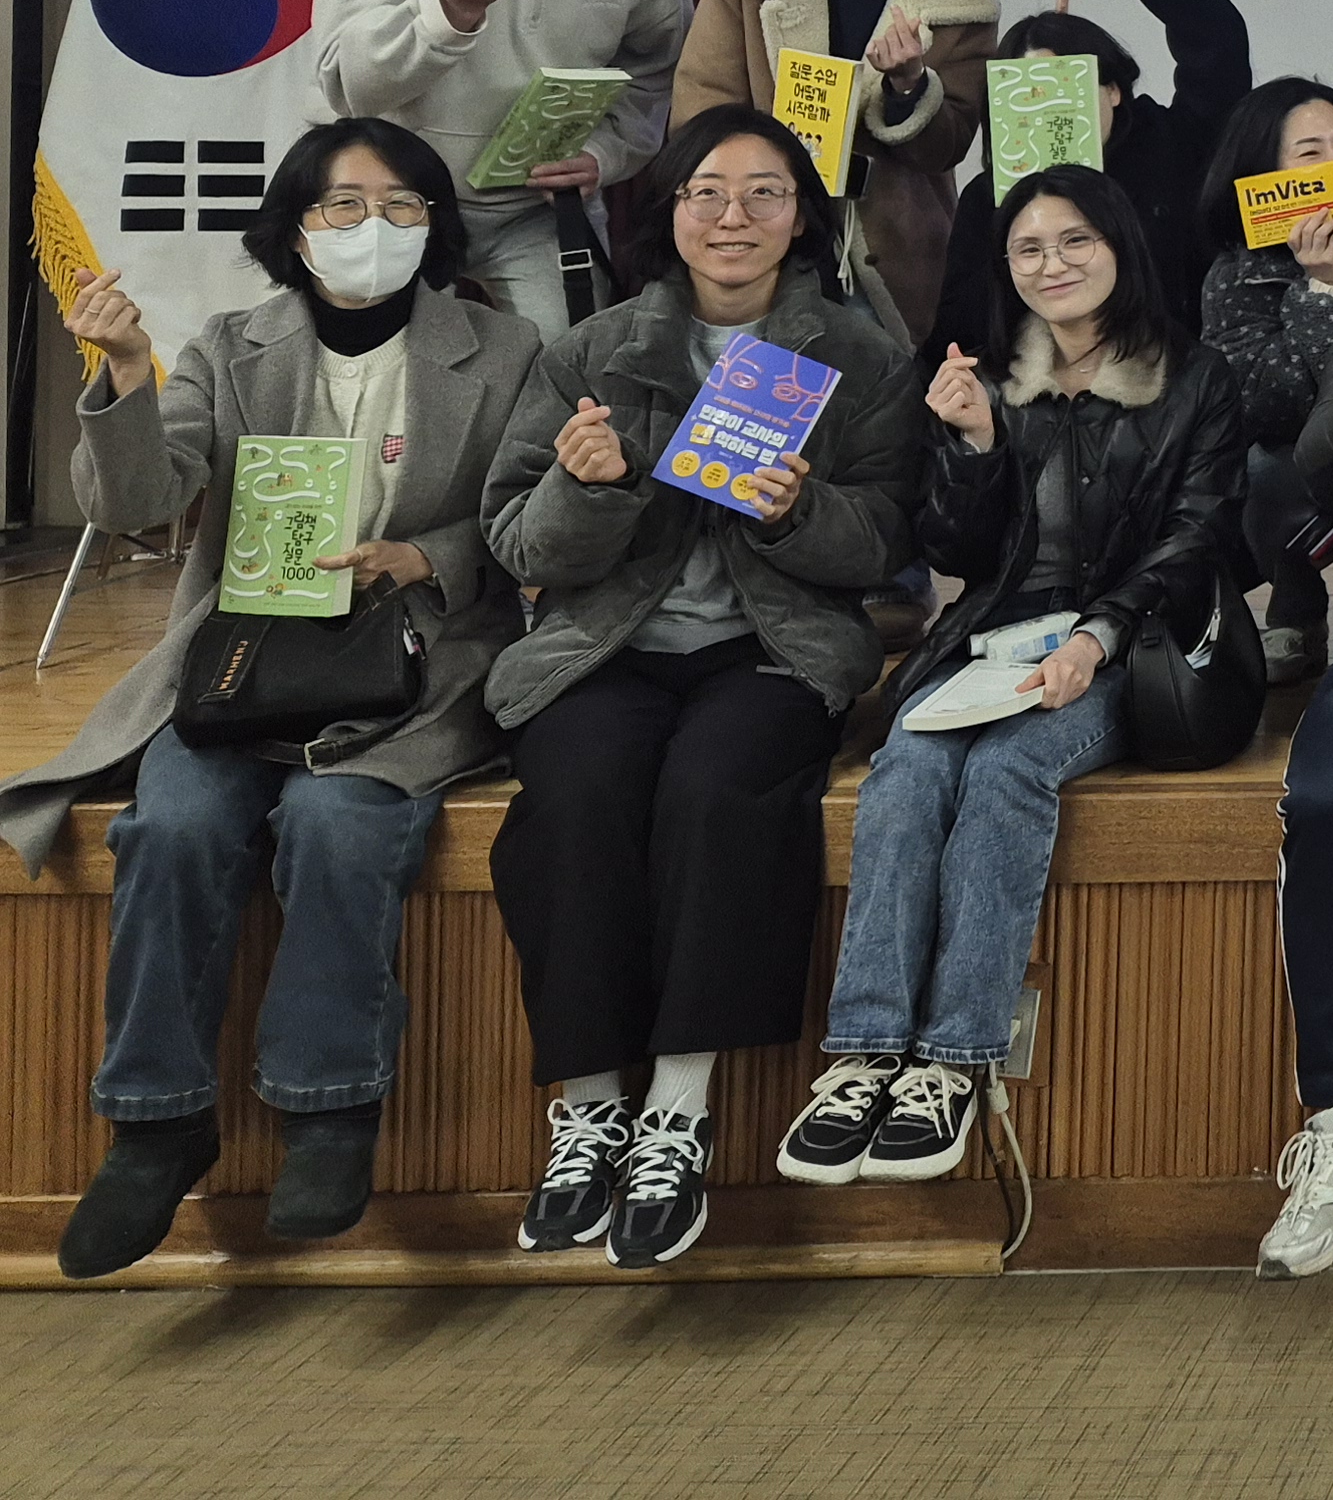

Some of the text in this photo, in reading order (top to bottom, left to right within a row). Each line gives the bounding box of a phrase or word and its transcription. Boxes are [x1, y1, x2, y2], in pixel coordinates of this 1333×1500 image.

[790, 61, 838, 86] 질문 수업
[794, 82, 827, 104] 어떻게
[786, 99, 831, 123] 시작할까
[743, 420, 789, 449] 교사의
[284, 510, 318, 531] 그림책
[291, 529, 314, 547] 탐구
[283, 542, 304, 566] 질문
[281, 566, 316, 581] 1000
